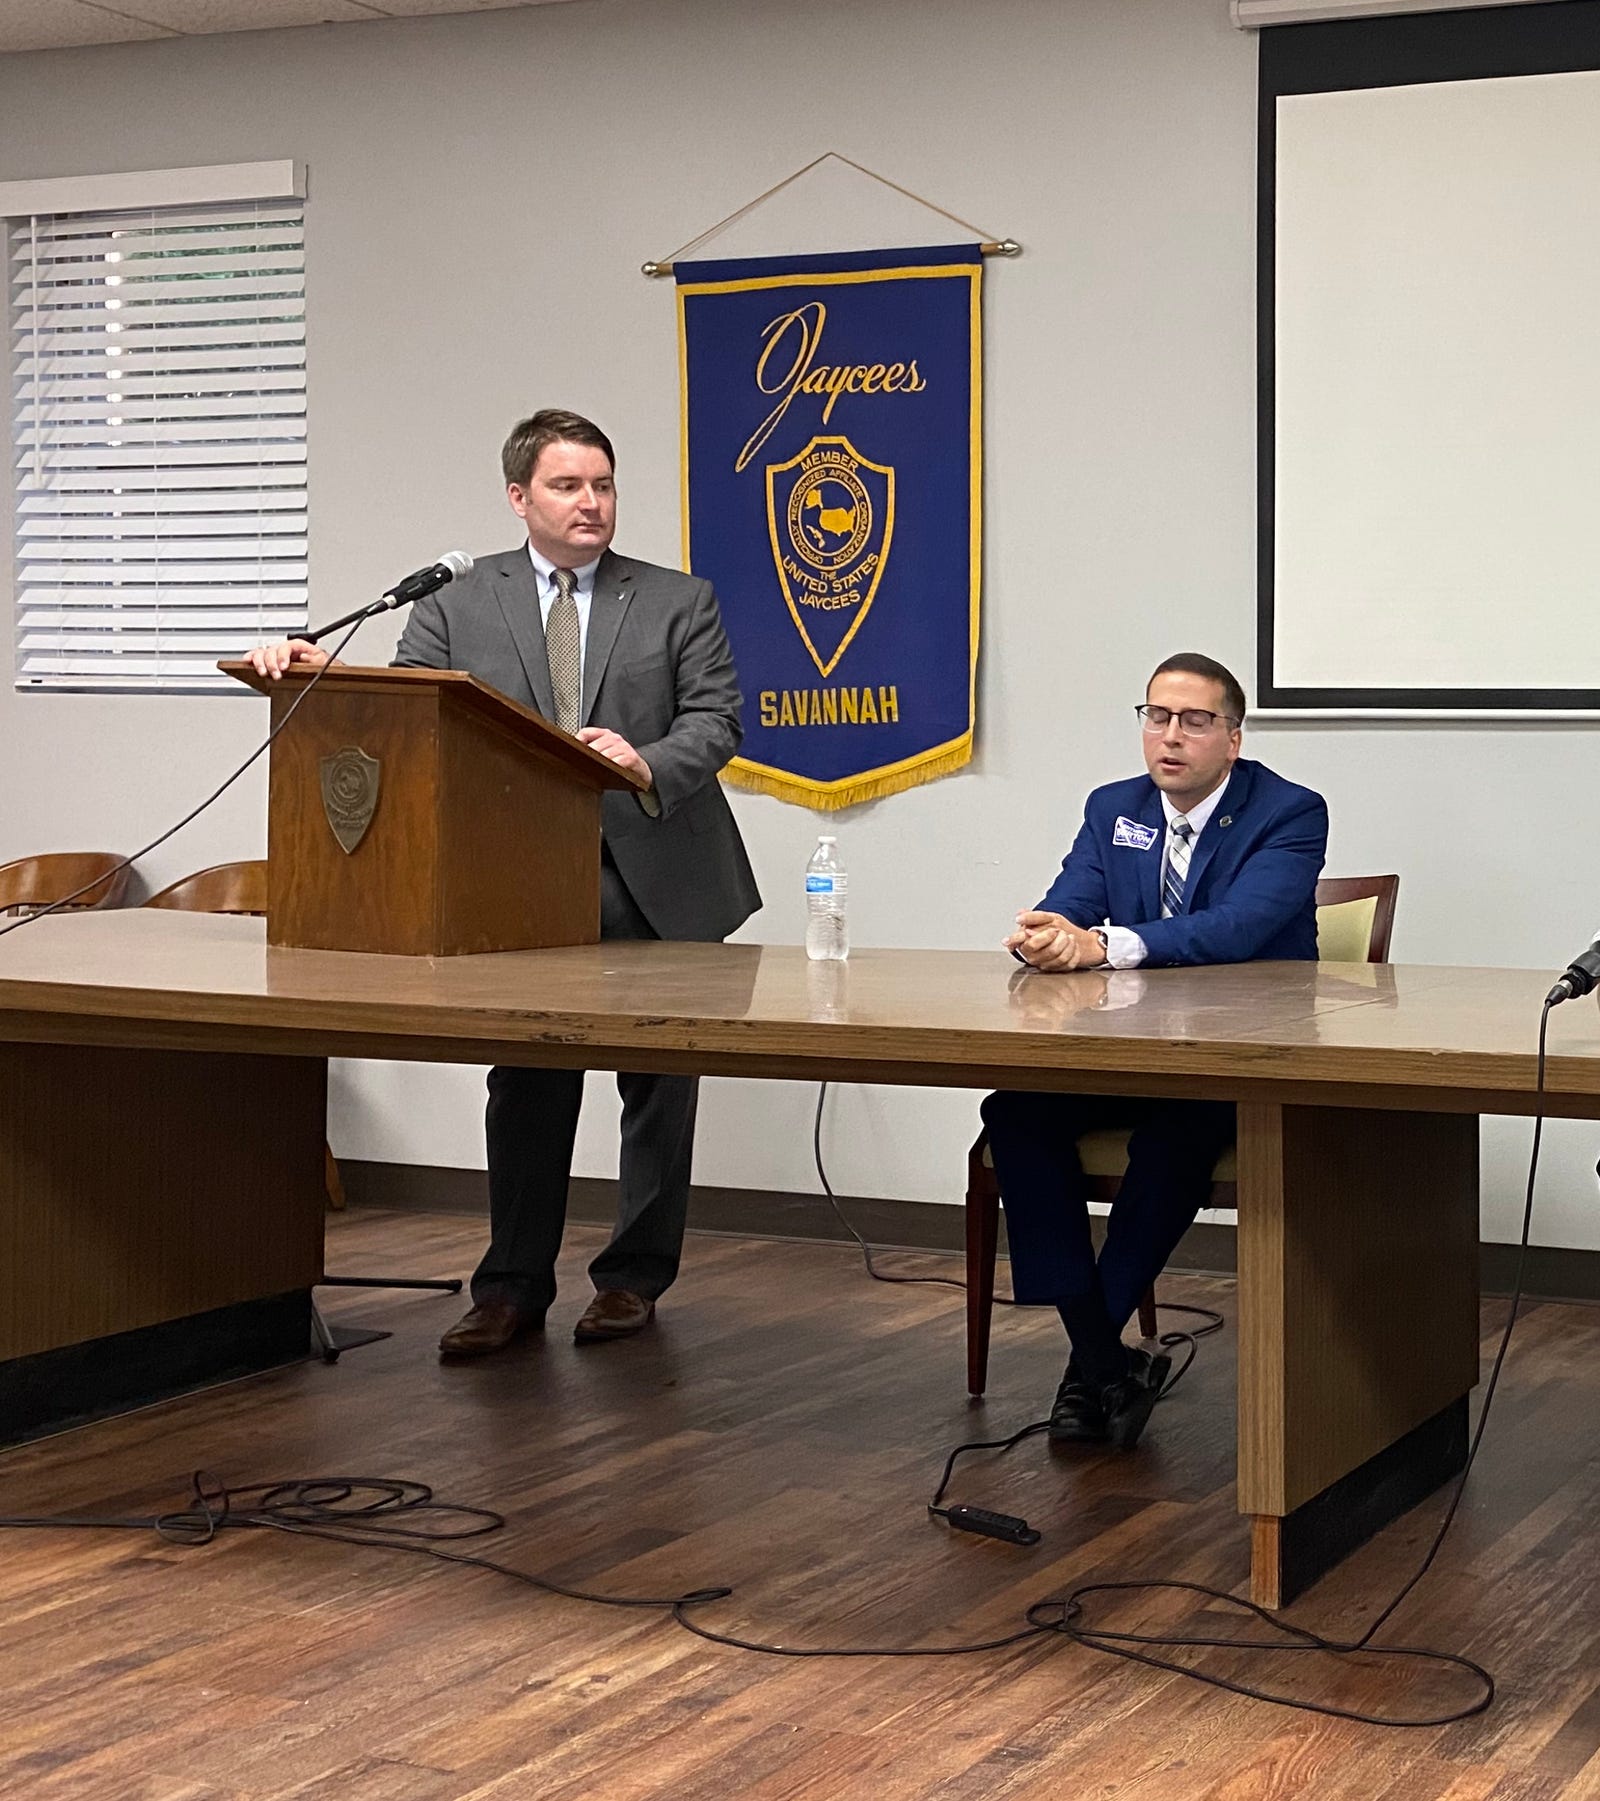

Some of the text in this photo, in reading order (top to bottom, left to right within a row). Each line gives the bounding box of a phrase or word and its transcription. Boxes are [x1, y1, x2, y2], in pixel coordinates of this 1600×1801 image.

[735, 301, 926, 473] Jaycees
[801, 451, 859, 473] MEMBER
[791, 470, 826, 522] RECOGNIZED
[829, 470, 863, 500] AFFILIATE
[834, 501, 867, 564] ORGANIZATION
[782, 552, 879, 594] UNITED STATES
[820, 571, 837, 581] THE
[799, 589, 861, 611] JAYCEES
[759, 685, 899, 727] SAVANNAH
